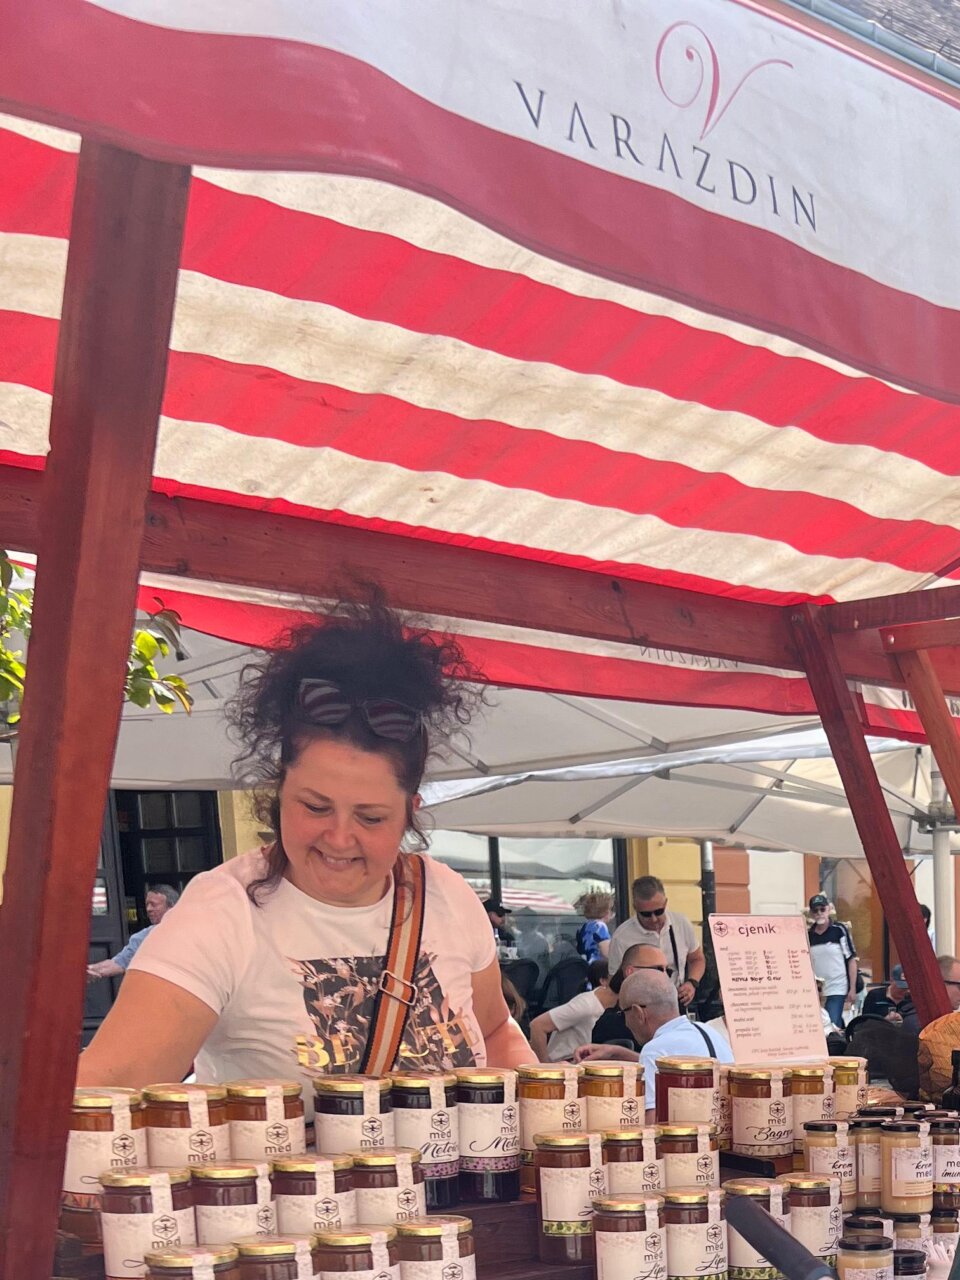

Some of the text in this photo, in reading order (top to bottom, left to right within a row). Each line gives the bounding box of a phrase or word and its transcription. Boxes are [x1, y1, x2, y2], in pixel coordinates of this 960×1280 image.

[738, 923, 776, 937] cjenik
[562, 1118, 582, 1129] med
[620, 1116, 640, 1125] med
[767, 1117, 786, 1125] med
[500, 1125, 518, 1133] med
[429, 1130, 452, 1140] med
[360, 1136, 384, 1147] med
[265, 1142, 292, 1155] med
[110, 1156, 138, 1168] med
[188, 1151, 217, 1163] med
[695, 1173, 715, 1182] med
[832, 1169, 853, 1178] med
[641, 1181, 661, 1191] med
[396, 1209, 420, 1221] med
[314, 1218, 342, 1230] med
[152, 1236, 182, 1250] med
[705, 1242, 724, 1252] med
[643, 1251, 664, 1262] med
